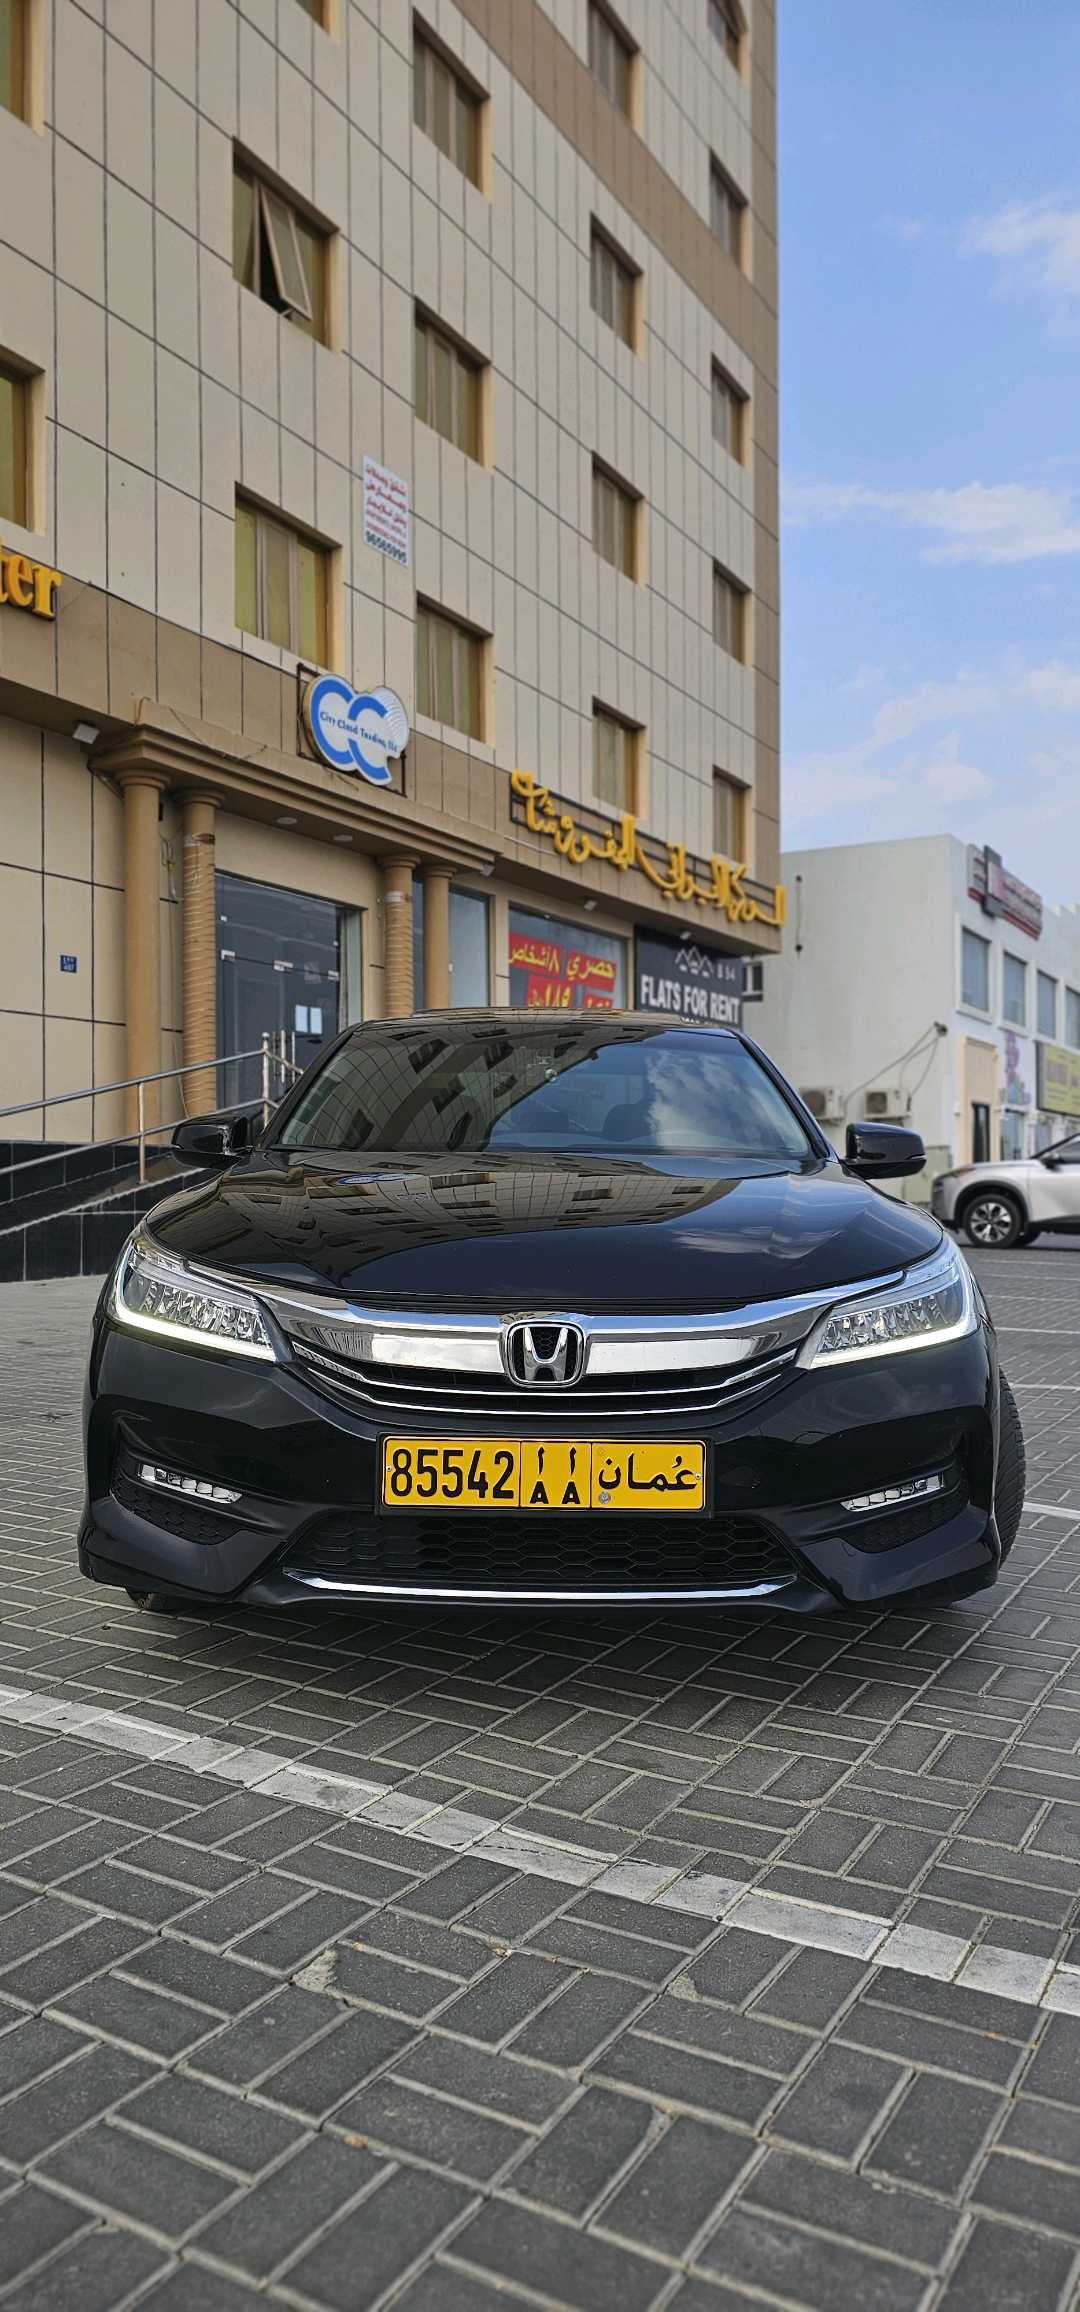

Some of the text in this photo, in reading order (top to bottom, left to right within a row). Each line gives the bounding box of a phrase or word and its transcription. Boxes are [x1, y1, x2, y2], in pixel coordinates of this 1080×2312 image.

[320, 711, 336, 727] City
[640, 974, 740, 1024] FLATS FOR RENT
[390, 1447, 515, 1500] 85542
